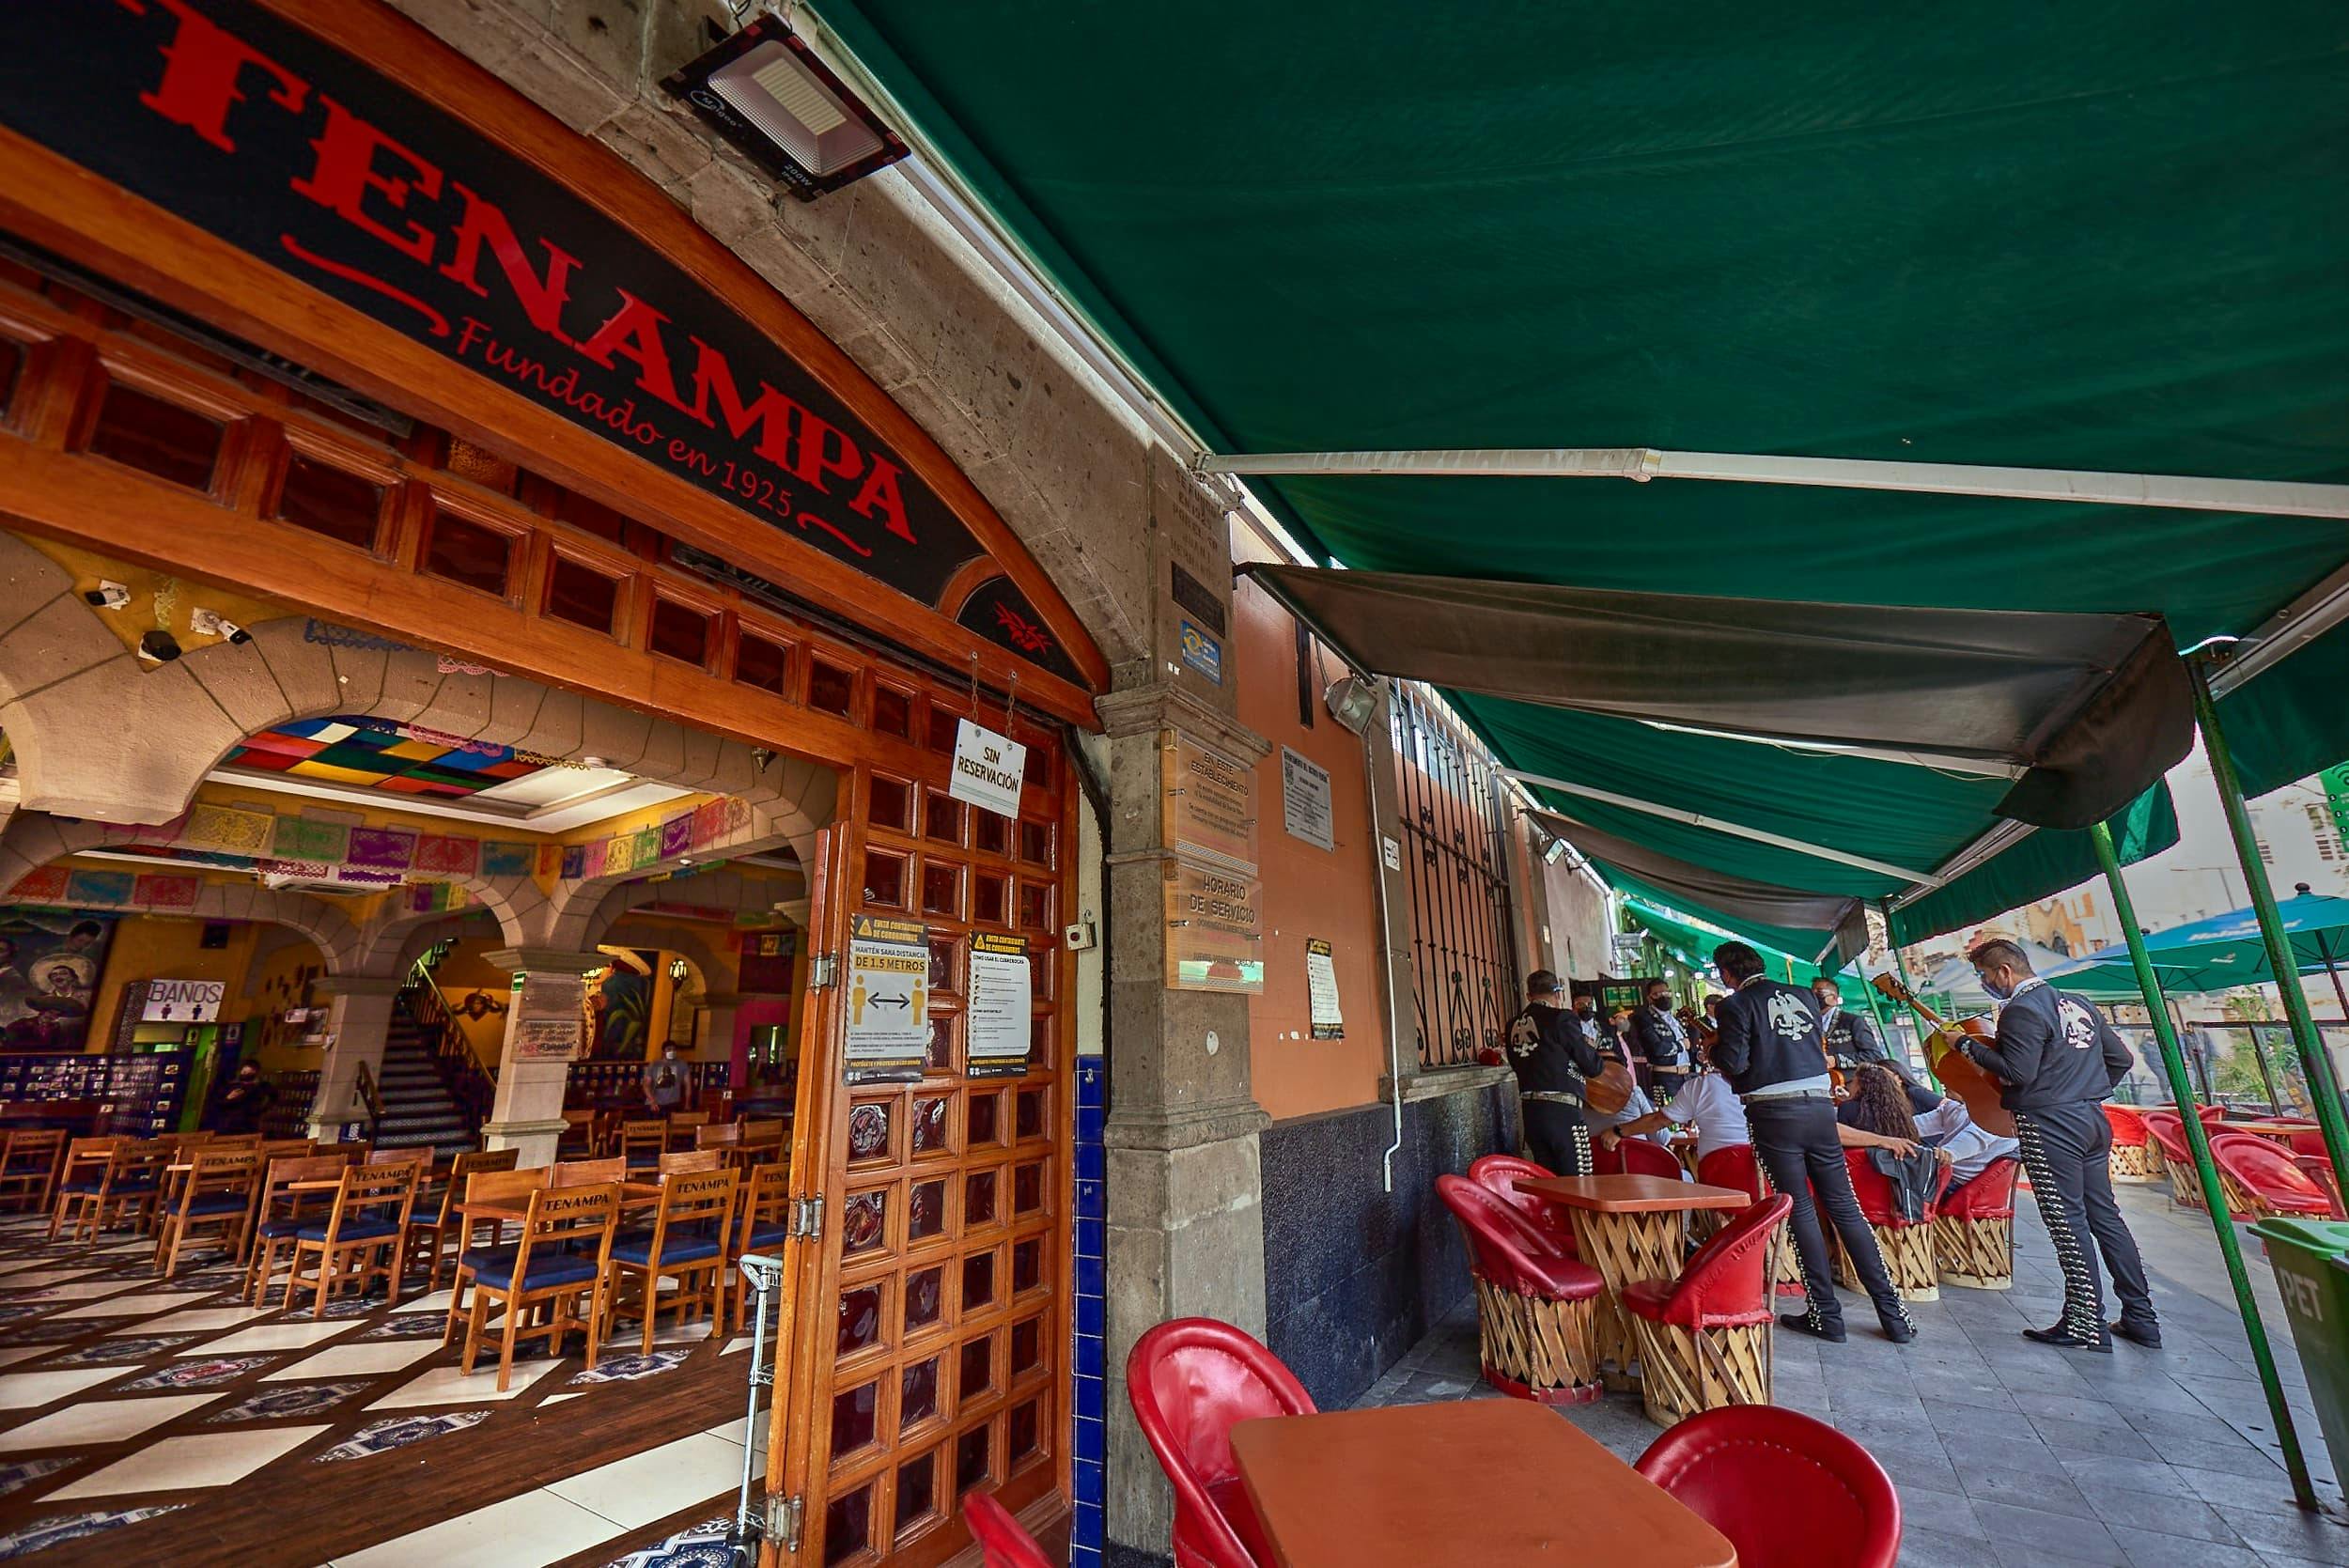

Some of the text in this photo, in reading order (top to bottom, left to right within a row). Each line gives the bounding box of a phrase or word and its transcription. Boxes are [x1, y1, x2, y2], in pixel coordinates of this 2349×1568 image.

[784, 163, 813, 187] 200W
[116, 0, 917, 544] TENAMPA
[457, 316, 793, 518] Fundado en 1925
[983, 746, 1001, 765] SIN
[1217, 758, 1234, 776] ESTE
[957, 755, 1019, 793] RESERVACIÓN
[1190, 759, 1249, 797] ESTABLECIMIENTO
[1203, 875, 1246, 901] HORARIO
[1190, 893, 1255, 924] DE SERVICIO
[856, 956, 926, 971] DE 1.5 METROS
[896, 949, 926, 958] DISTANCIA
[353, 1168, 413, 1182] TENAMPA
[677, 1178, 730, 1194] TENAMPA
[545, 1193, 610, 1212] TENAMPA
[2279, 1267, 2324, 1323] PET
